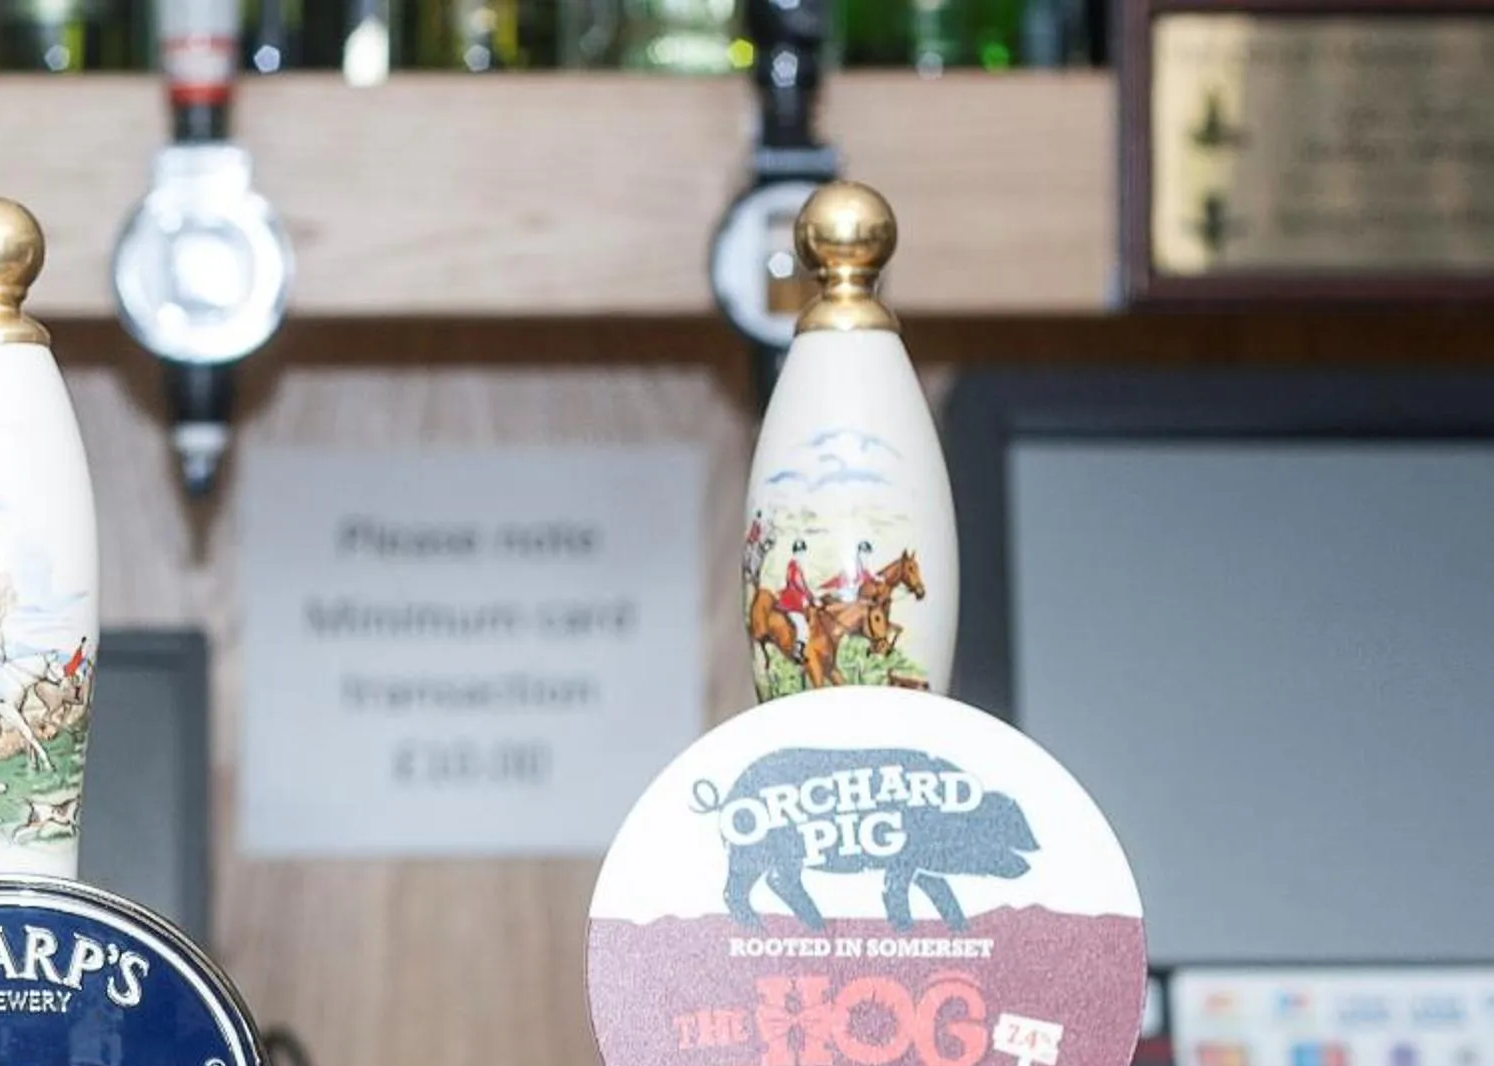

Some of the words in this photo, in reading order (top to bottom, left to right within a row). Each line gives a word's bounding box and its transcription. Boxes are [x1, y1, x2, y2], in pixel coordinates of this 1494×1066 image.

[719, 766, 984, 845] ORCHARD
[797, 811, 907, 866] PIG
[729, 937, 831, 957] ROOTED
[835, 937, 863, 957] IN
[866, 937, 995, 957] SOMERSET
[673, 1008, 753, 1050] THE
